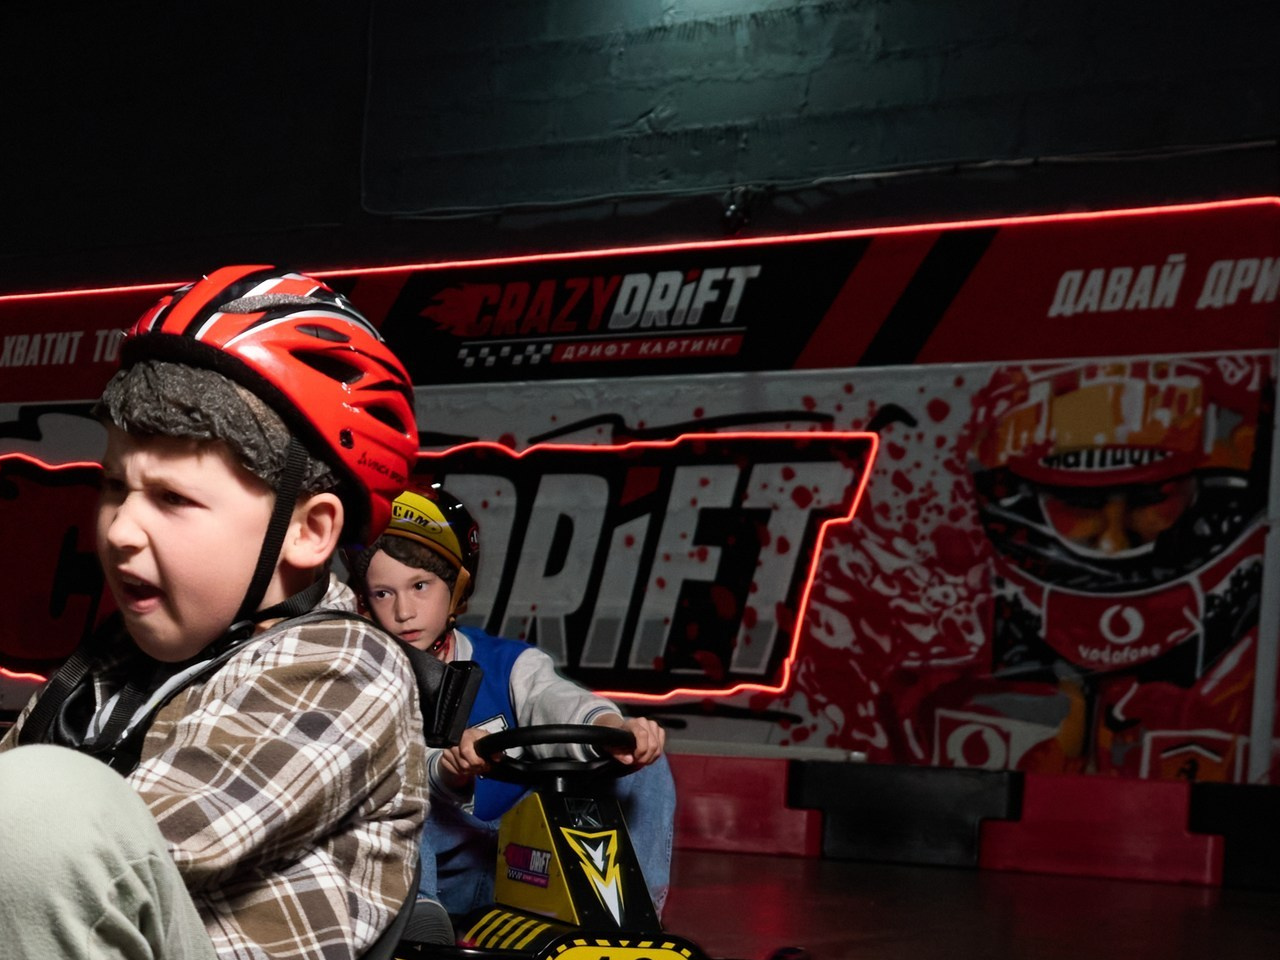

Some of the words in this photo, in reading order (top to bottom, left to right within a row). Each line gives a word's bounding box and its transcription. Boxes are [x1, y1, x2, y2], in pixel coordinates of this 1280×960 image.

[1046, 253, 1187, 318] ДАВАЙ
[559, 341, 632, 361] ДРИФТ
[639, 337, 733, 357] КАРТИНГ
